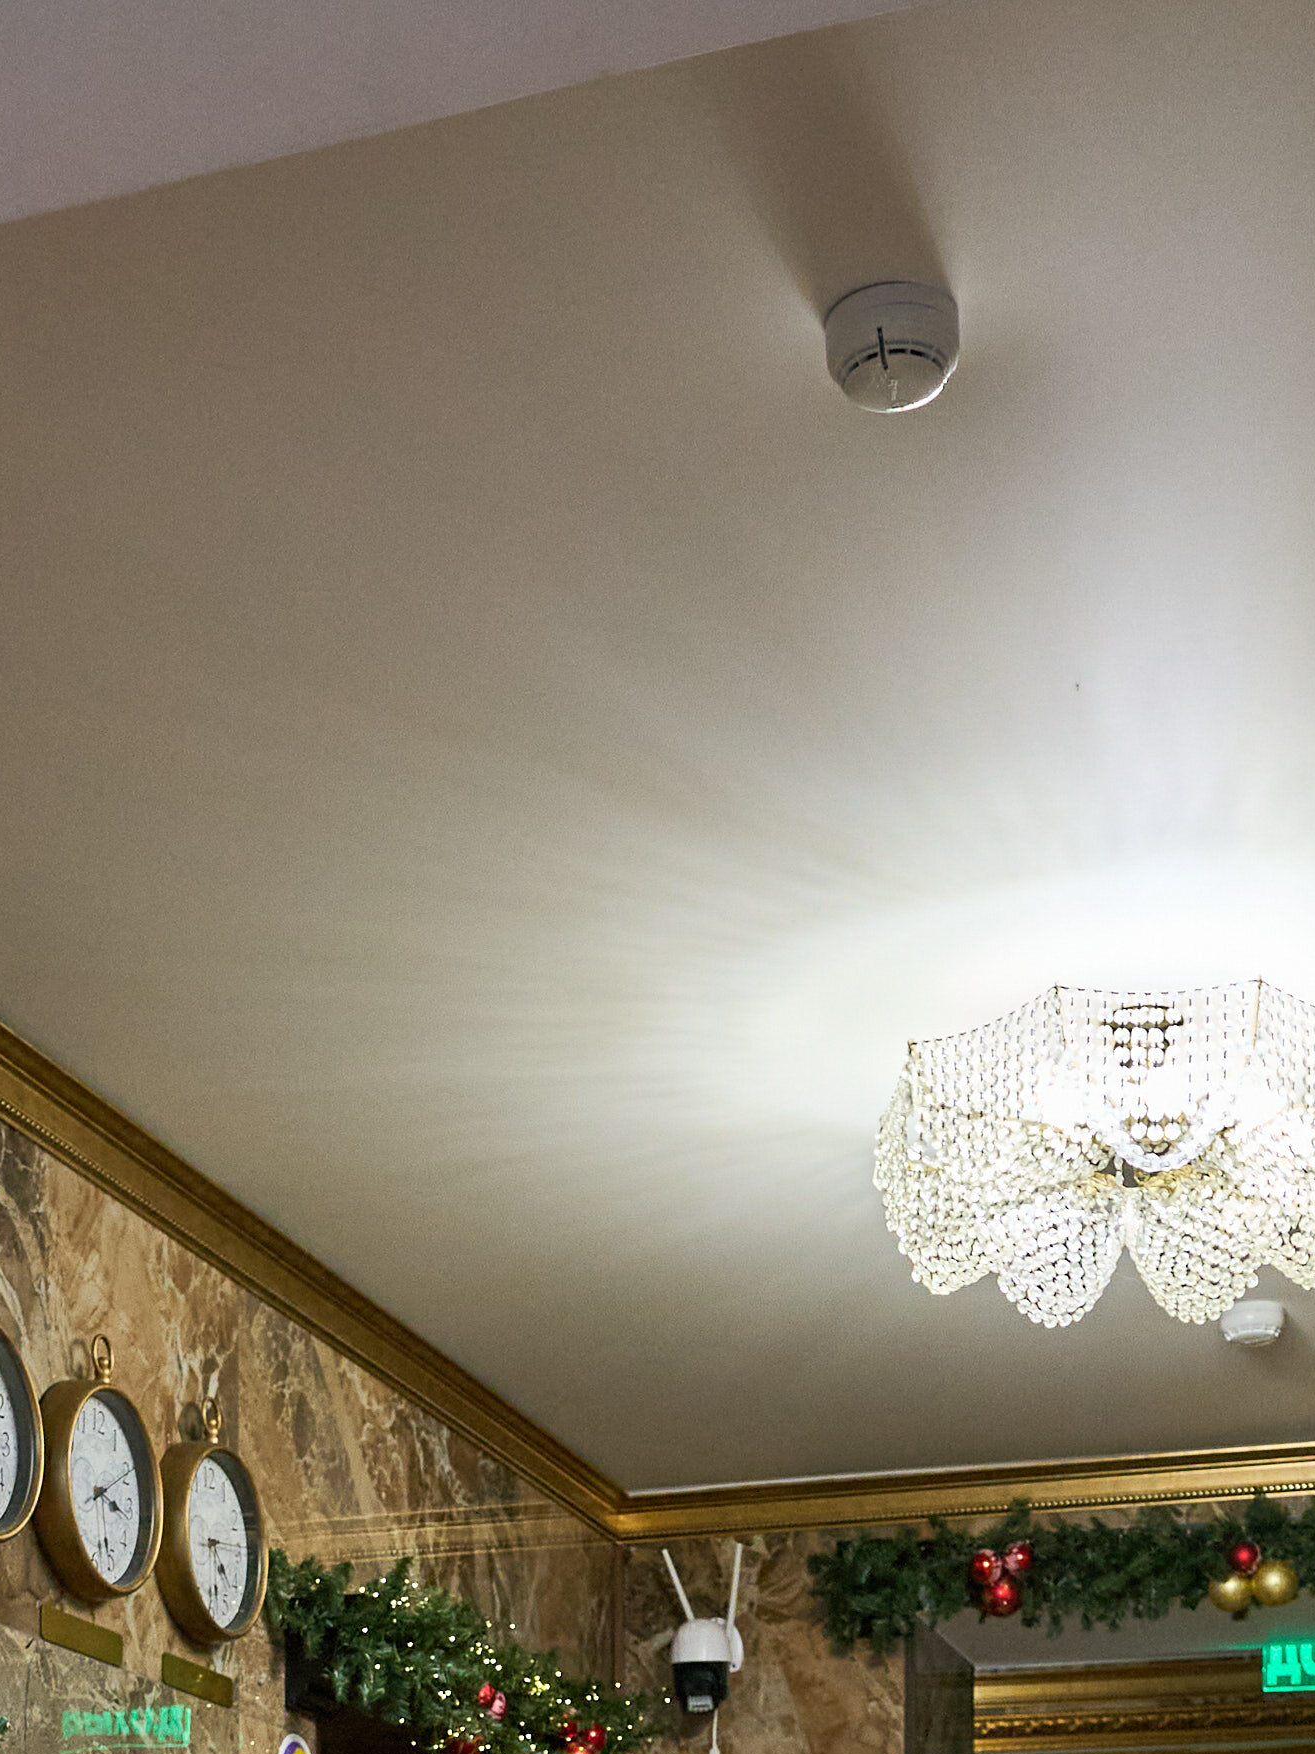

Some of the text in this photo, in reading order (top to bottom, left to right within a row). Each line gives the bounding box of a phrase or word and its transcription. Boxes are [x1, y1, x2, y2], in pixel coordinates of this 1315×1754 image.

[92, 1407, 105, 1435] 12
[2, 1431, 11, 1457] 3
[203, 1466, 215, 1490] 12
